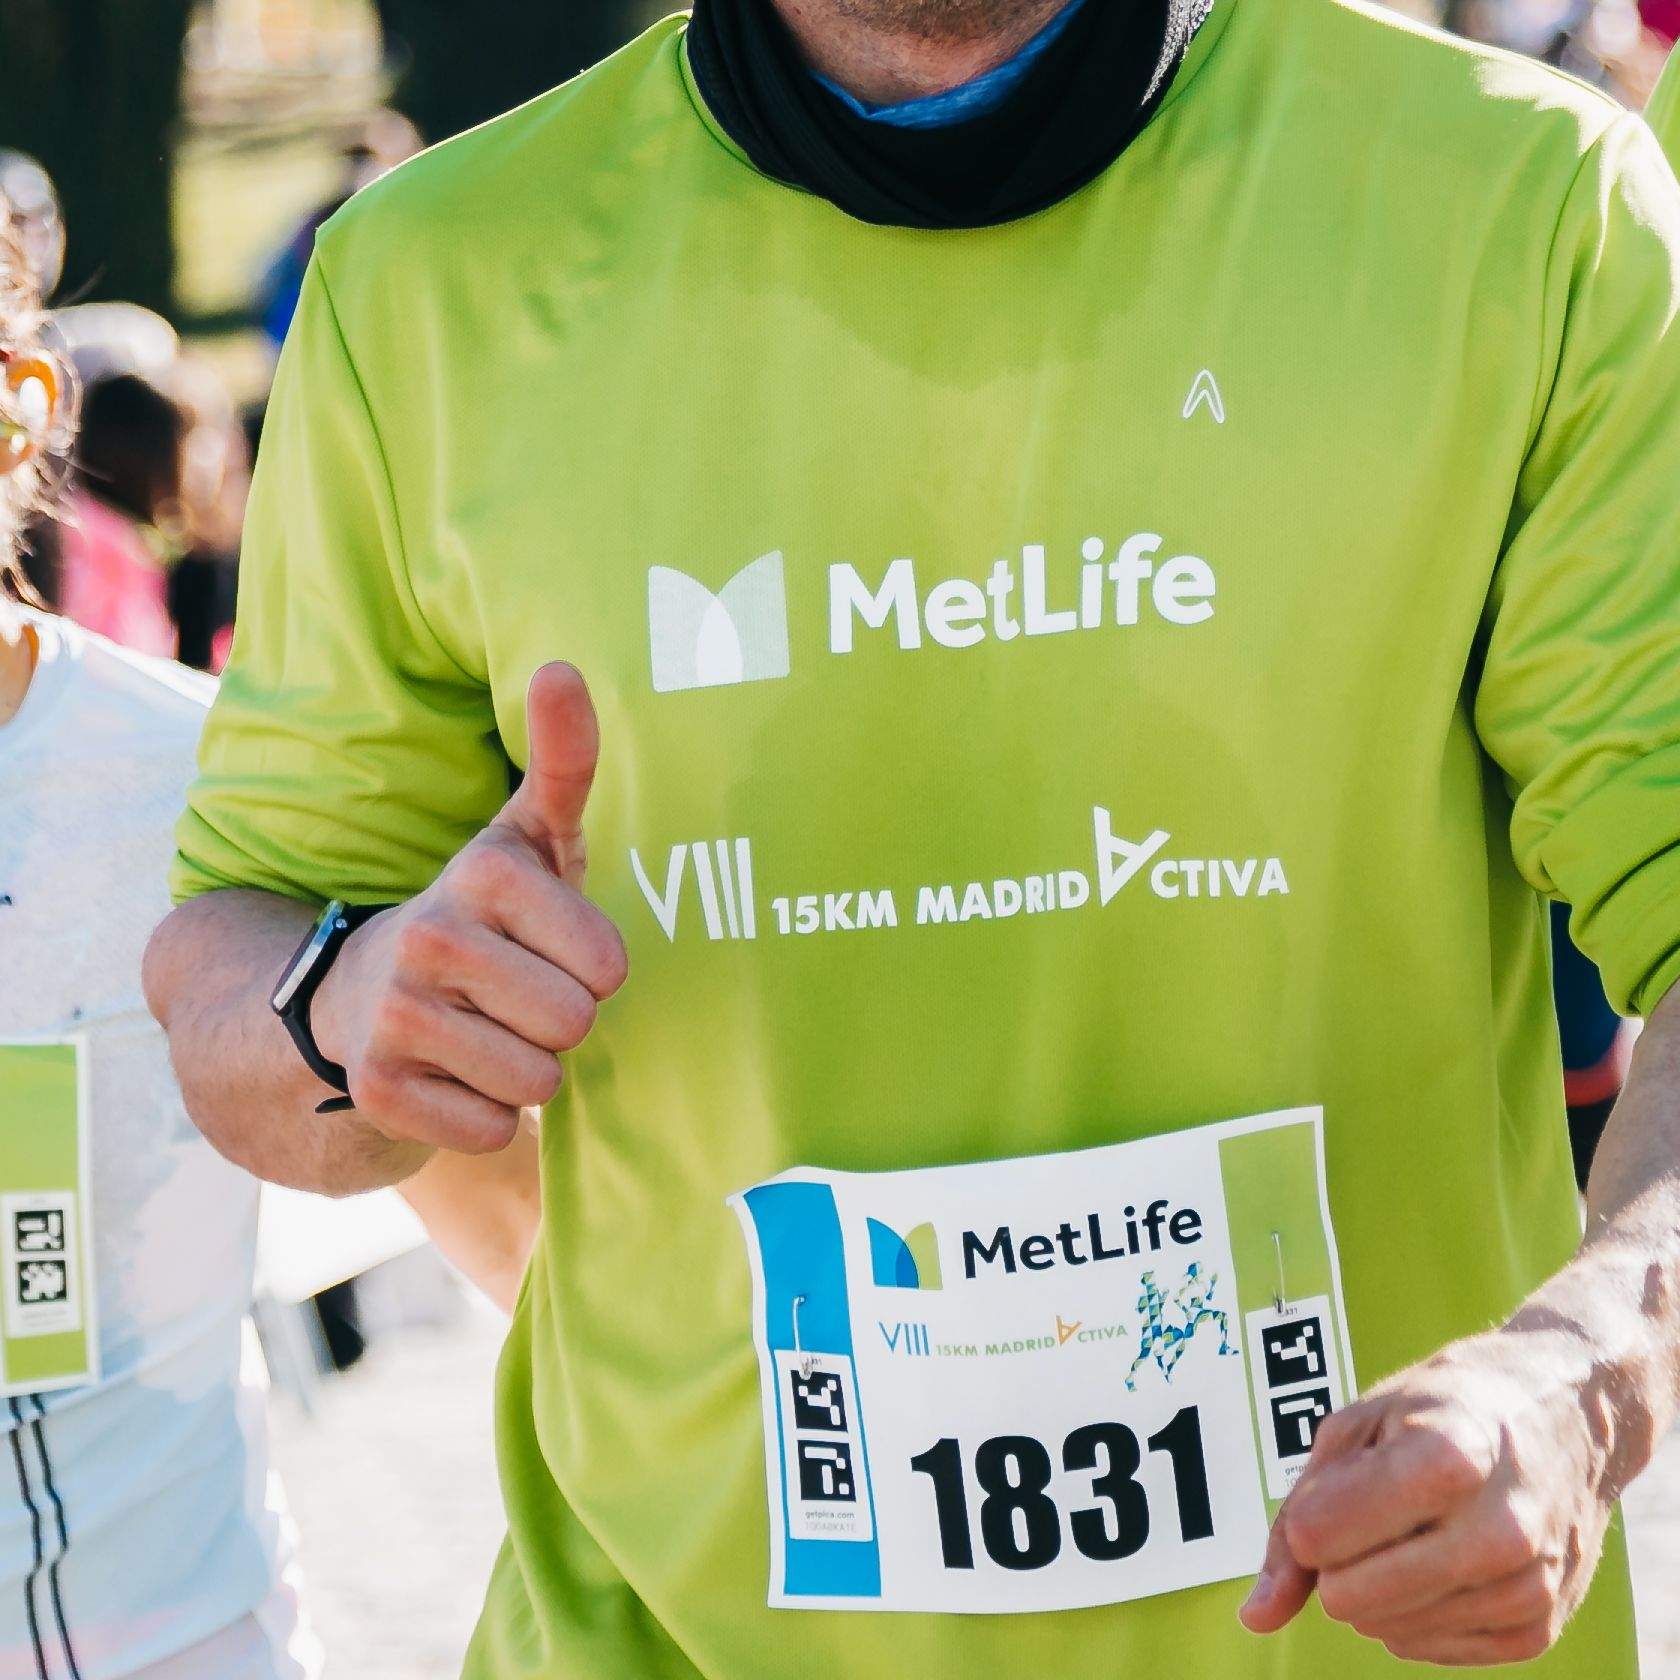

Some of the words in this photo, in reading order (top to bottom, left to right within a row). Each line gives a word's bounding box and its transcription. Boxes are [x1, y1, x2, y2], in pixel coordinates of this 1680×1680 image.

[828, 531, 1216, 654] MetLife
[630, 836, 757, 944] VIII
[771, 888, 898, 935] 15KM
[915, 870, 1091, 924] MADRID
[961, 1198, 1202, 1280] MetLife
[877, 1320, 931, 1357] VIII
[934, 1343, 979, 1357] 15KM
[984, 1335, 1056, 1356] MADRID
[909, 1404, 1216, 1572] 1831
